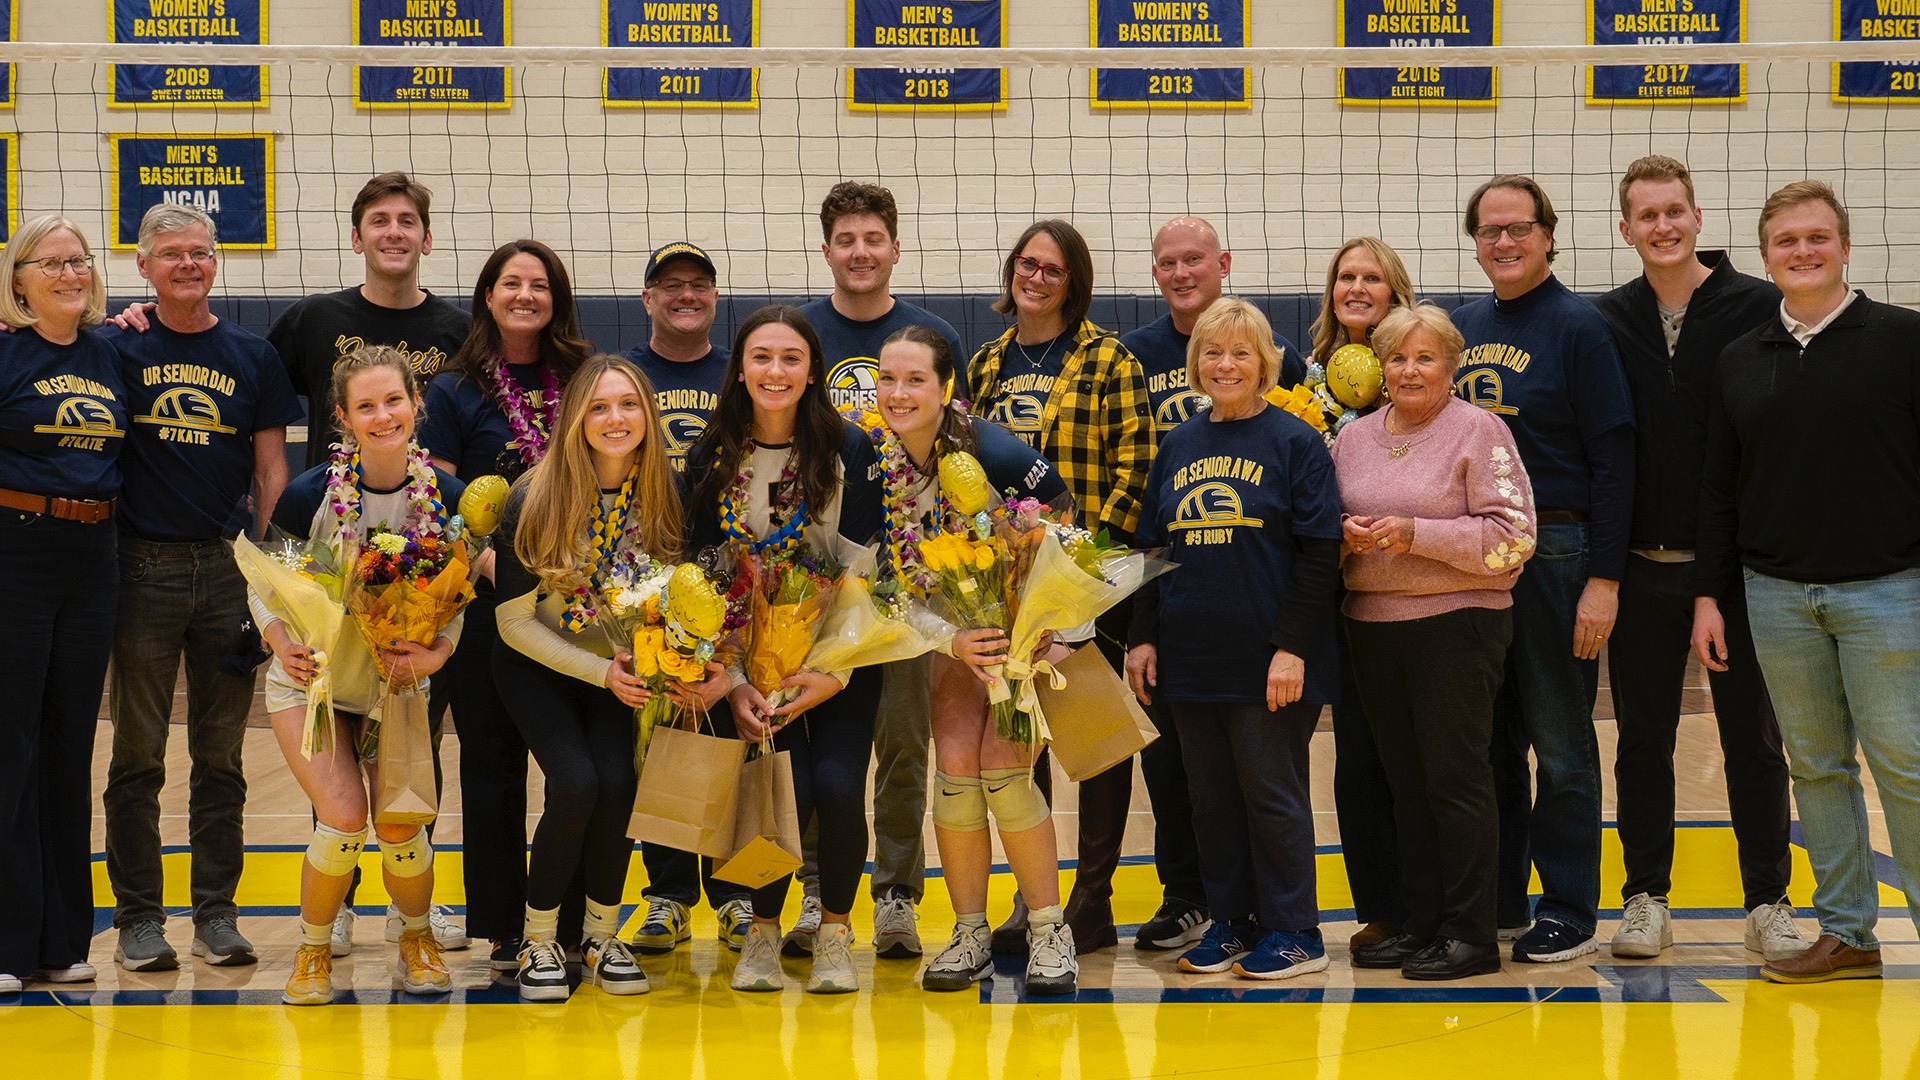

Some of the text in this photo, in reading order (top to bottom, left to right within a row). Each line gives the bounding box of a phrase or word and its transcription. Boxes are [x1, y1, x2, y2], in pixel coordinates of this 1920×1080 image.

[149, 0, 226, 17] WOMEN'S
[405, 0, 457, 18] MEN'S
[643, 3, 719, 22] WOMEN'S
[901, 6, 953, 25] MEN'S
[1132, 2, 1209, 21] WOMEN'S
[1641, 0, 1694, 13] MENS
[134, 18, 240, 37] BASKETBALL
[380, 19, 483, 38] BASKETBALL
[1367, 14, 1470, 34] BASKETBALL
[1614, 13, 1720, 32] BASKETBALL
[628, 23, 732, 43] BASKETBALL
[875, 26, 980, 46] BASKETBALL
[1118, 23, 1222, 43] BASKETBALL
[165, 67, 210, 86] 2009
[412, 67, 453, 85] 2011
[1396, 66, 1440, 83] 2016
[1643, 64, 1689, 83] 2017
[396, 88, 469, 100] SWEET SIXTEEN
[659, 75, 700, 94] 2011
[904, 79, 949, 98] 2013
[1148, 75, 1193, 94] 2013
[1391, 86, 1446, 97] ELITE EIGHT
[1638, 85, 1696, 97] ELITE EIGHT
[151, 89, 224, 100] SWEET SIXTEEN
[166, 145, 218, 164] MEN'S
[139, 166, 245, 186] BASKETBALL
[163, 189, 220, 214] NCAA
[1467, 343, 1508, 366] SENIOR
[1501, 345, 1531, 373] DAD
[33, 374, 116, 401] UR SENIOR MOM
[142, 363, 236, 397] UR SENIOR DAD
[1000, 373, 1037, 394] SENIOR
[1033, 374, 1055, 393] MO
[1148, 373, 1167, 393] UR
[698, 390, 719, 411] DA
[829, 388, 878, 410] OCHES
[866, 460, 882, 481] UA
[1023, 458, 1050, 491] UAA
[1173, 466, 1189, 492] UR
[1188, 455, 1233, 483] SENIOR
[1184, 527, 1234, 546] #5 RUBY
